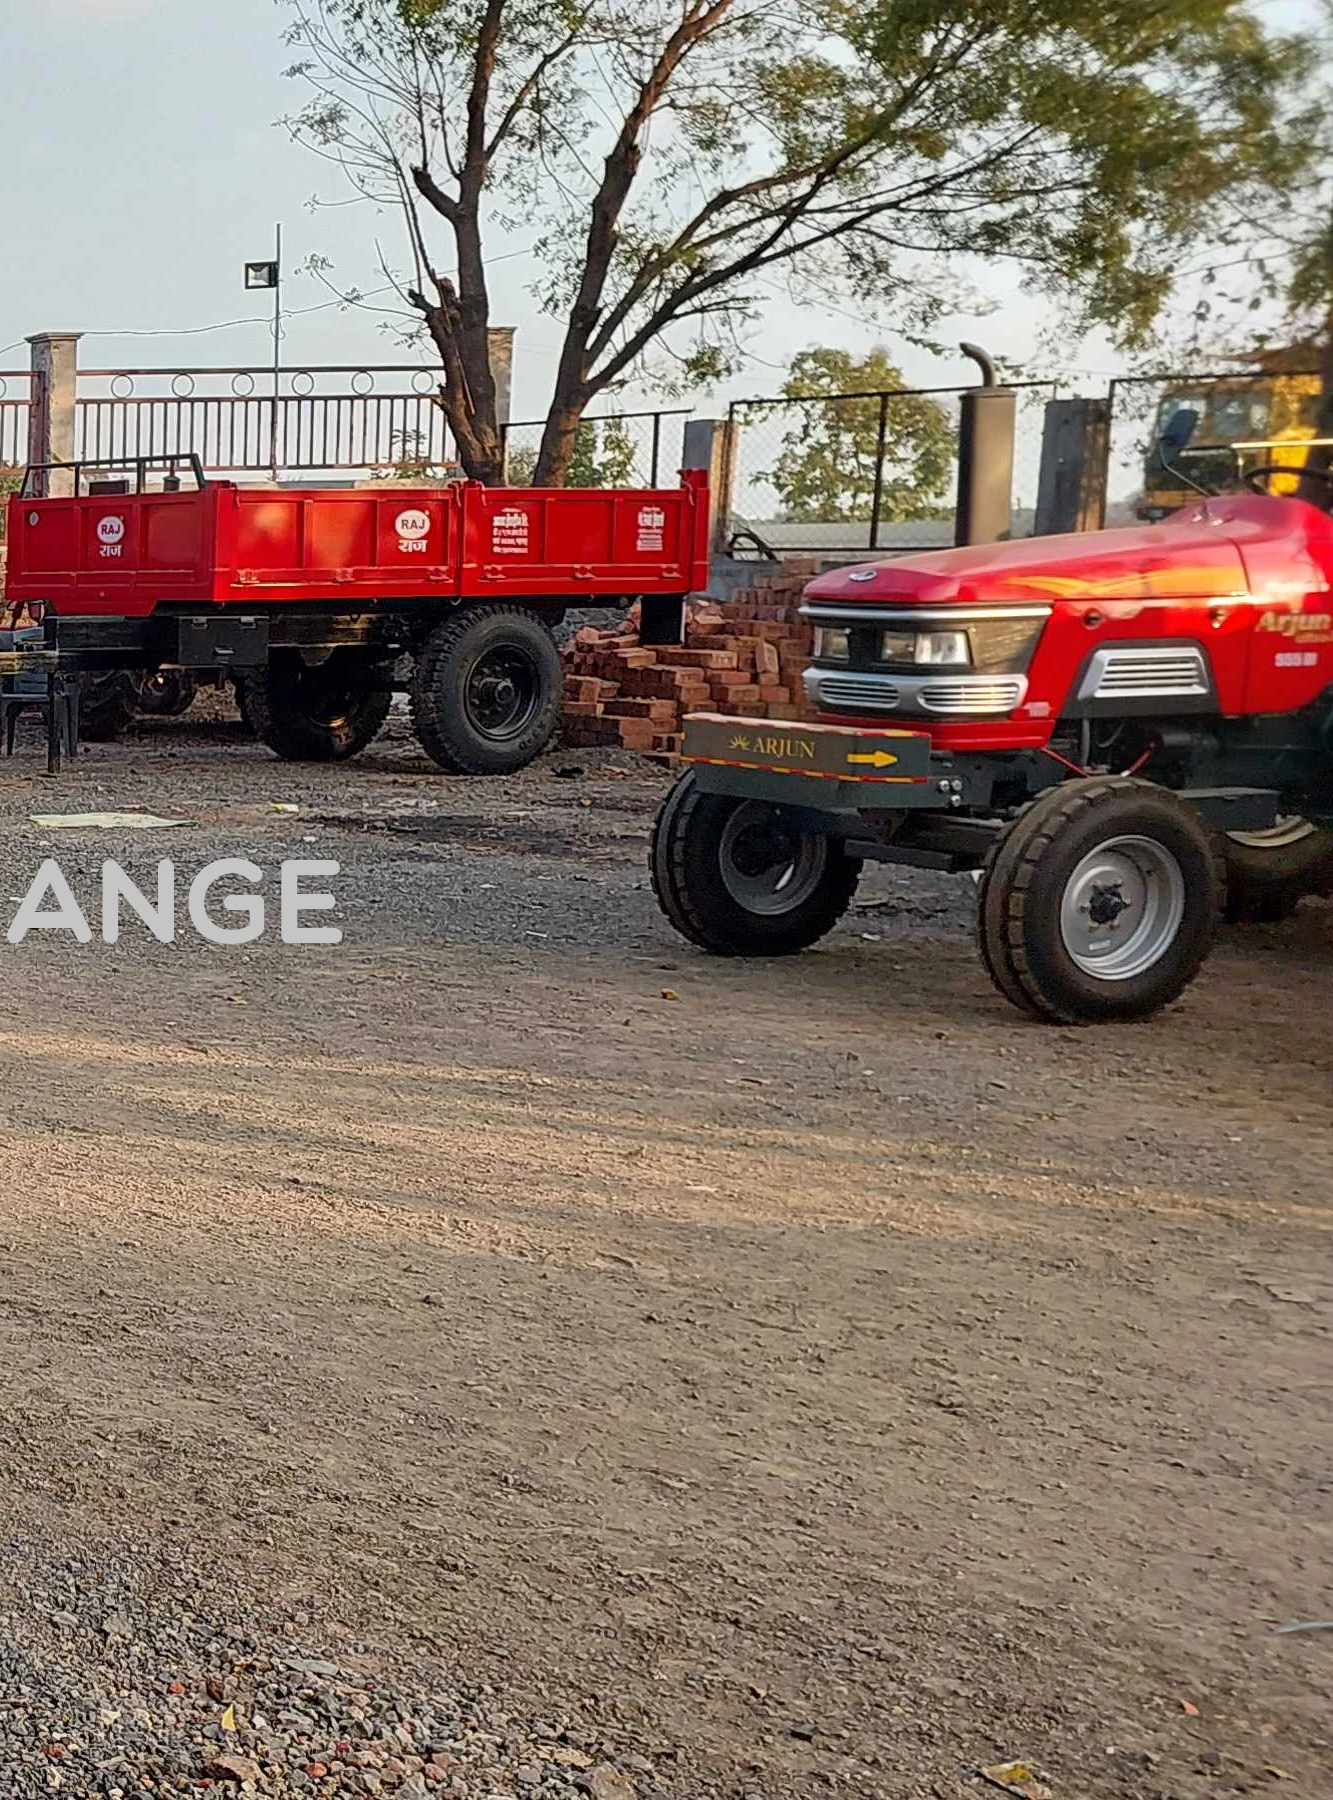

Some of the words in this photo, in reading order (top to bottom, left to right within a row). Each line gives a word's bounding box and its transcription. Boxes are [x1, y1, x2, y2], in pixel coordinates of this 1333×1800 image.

[101, 524, 121, 535] RAJ
[401, 519, 425, 530] RAJ
[753, 736, 815, 759] ARJUN
